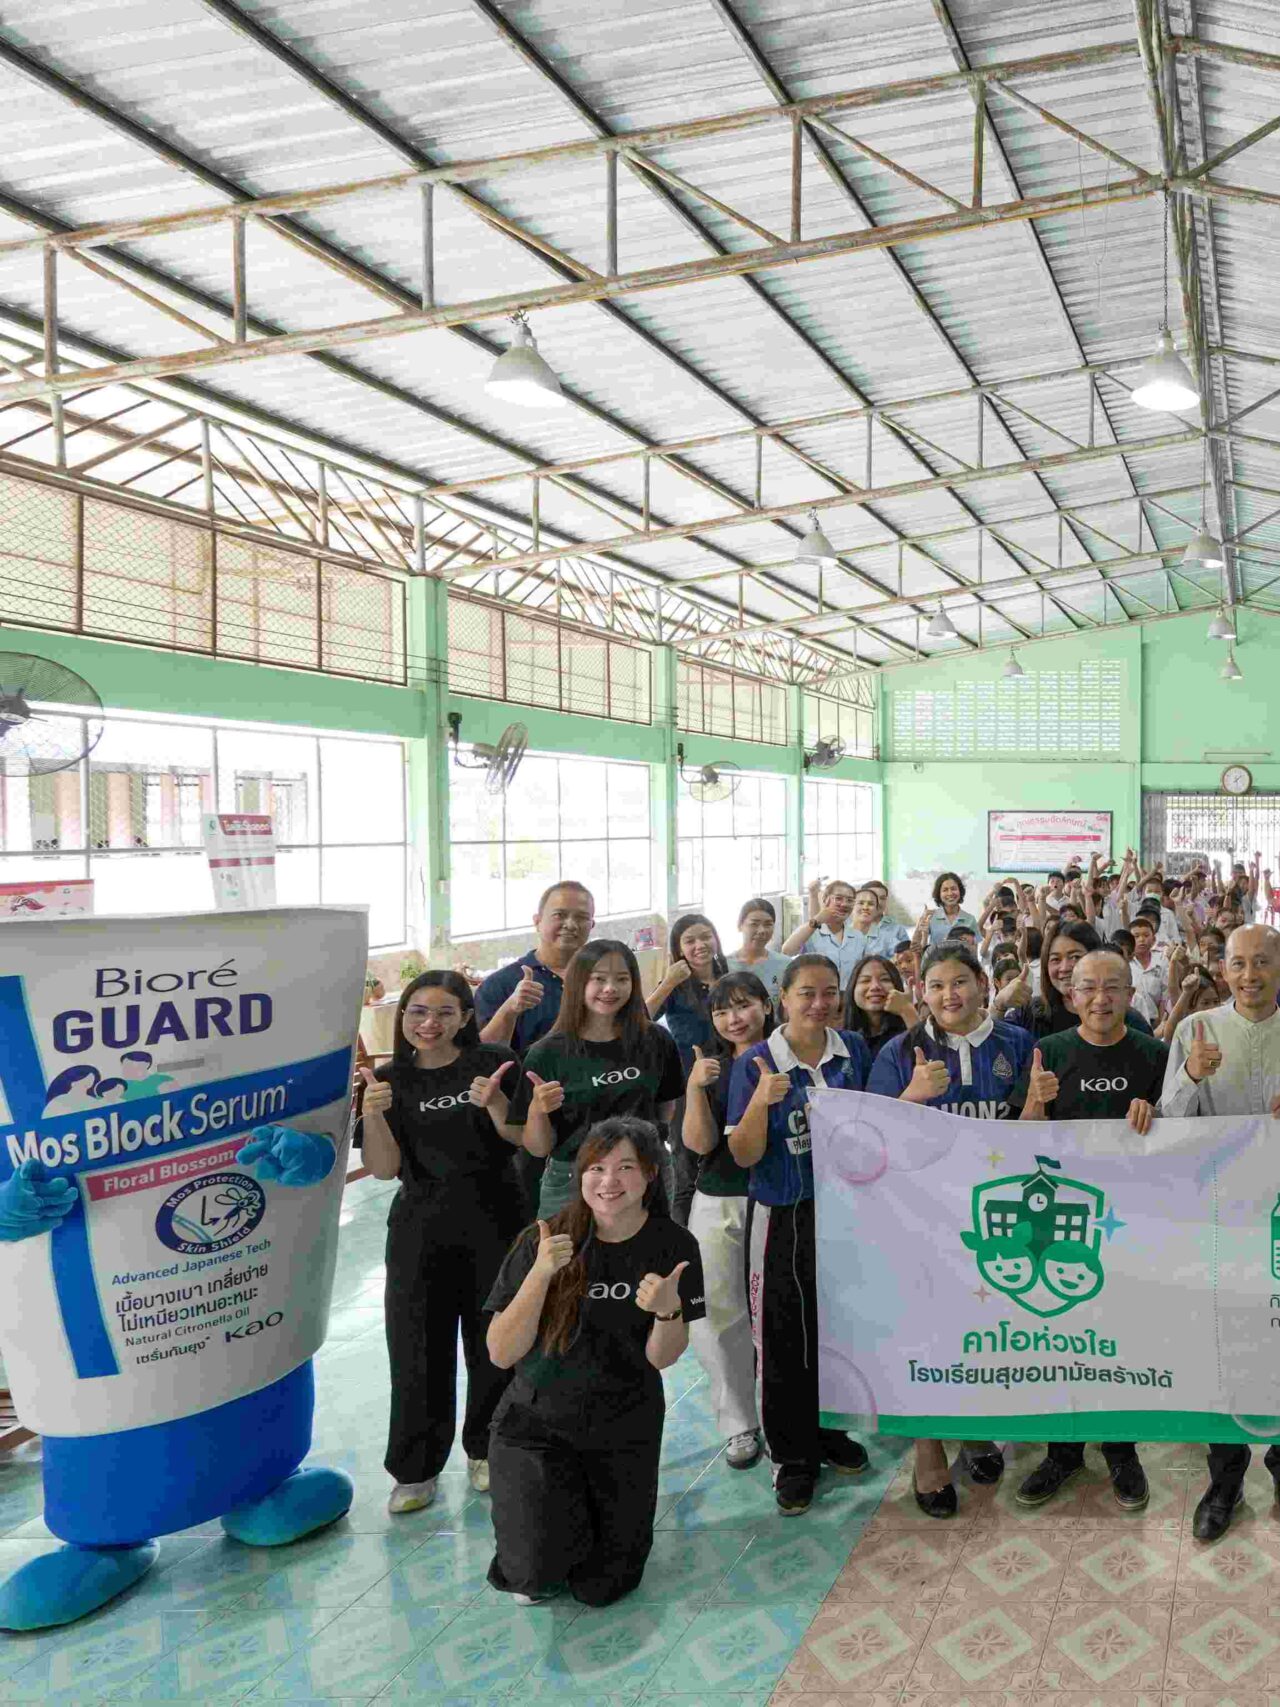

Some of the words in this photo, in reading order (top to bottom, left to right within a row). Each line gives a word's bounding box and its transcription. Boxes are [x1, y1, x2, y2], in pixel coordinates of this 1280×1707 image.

[94, 958, 239, 999] Bioré
[52, 992, 273, 1054] GUARD
[6, 1130, 80, 1169] Mos
[85, 1100, 183, 1161] Block
[103, 1170, 155, 1192] Floral
[160, 1148, 235, 1179] Blossom
[166, 1188, 192, 1208] Mos
[193, 1174, 254, 1190] Protection
[177, 1242, 207, 1254] Skin
[211, 1226, 252, 1252] Shield
[112, 1264, 179, 1286] Advanced
[182, 1249, 243, 1273] Japanese
[246, 1239, 271, 1255] Tech
[116, 1285, 203, 1313] เนื้อบางเบา
[208, 1263, 269, 1294] เกลี่ยง่าย
[588, 1281, 631, 1300] ao
[125, 1330, 172, 1347] Natural
[175, 1315, 233, 1337] Citronella
[235, 1306, 250, 1320] Oil
[963, 1321, 1117, 1357] คาโอห่วงใย
[908, 1360, 1173, 1389] โรงเรียนสุขอนามัยสร้างได้
